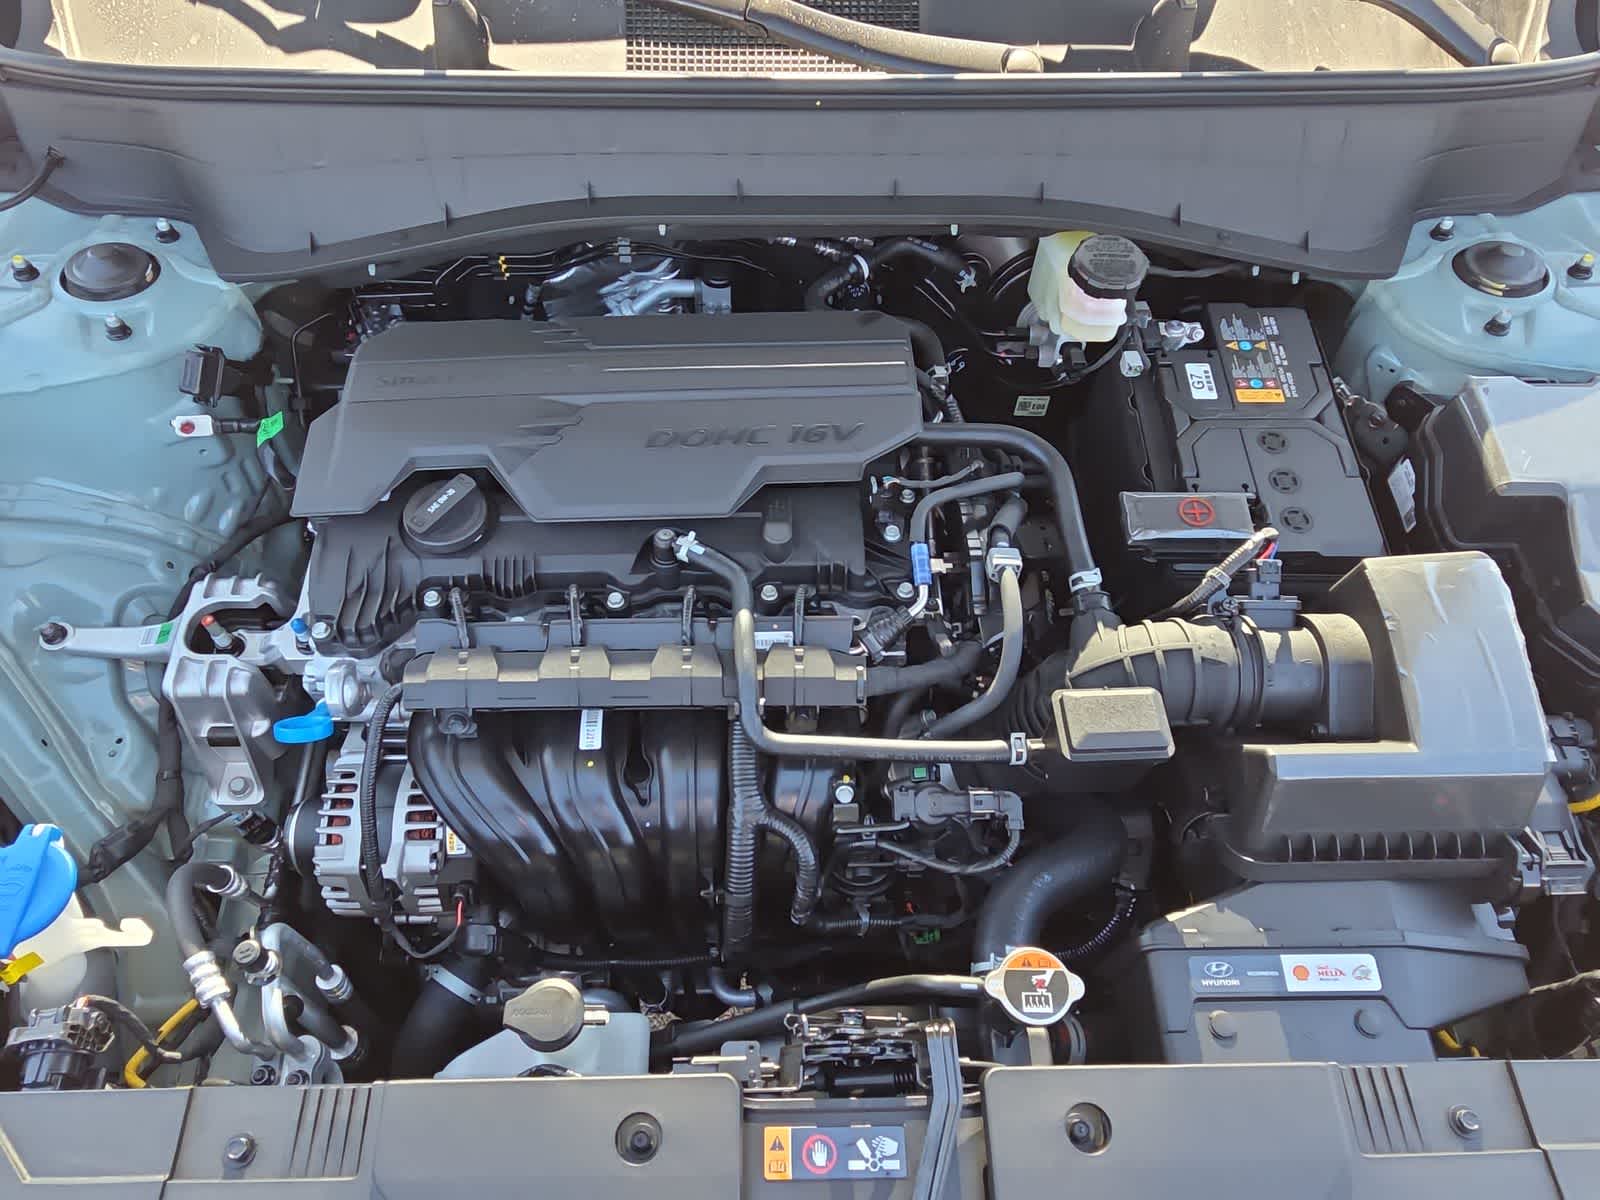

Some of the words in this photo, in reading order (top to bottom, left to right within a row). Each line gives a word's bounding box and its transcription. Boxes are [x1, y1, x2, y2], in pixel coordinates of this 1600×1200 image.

[1191, 373, 1205, 390] G7
[645, 424, 776, 449] DOHC
[787, 422, 864, 444] 16V
[1201, 979, 1240, 987] HYUNDAI
